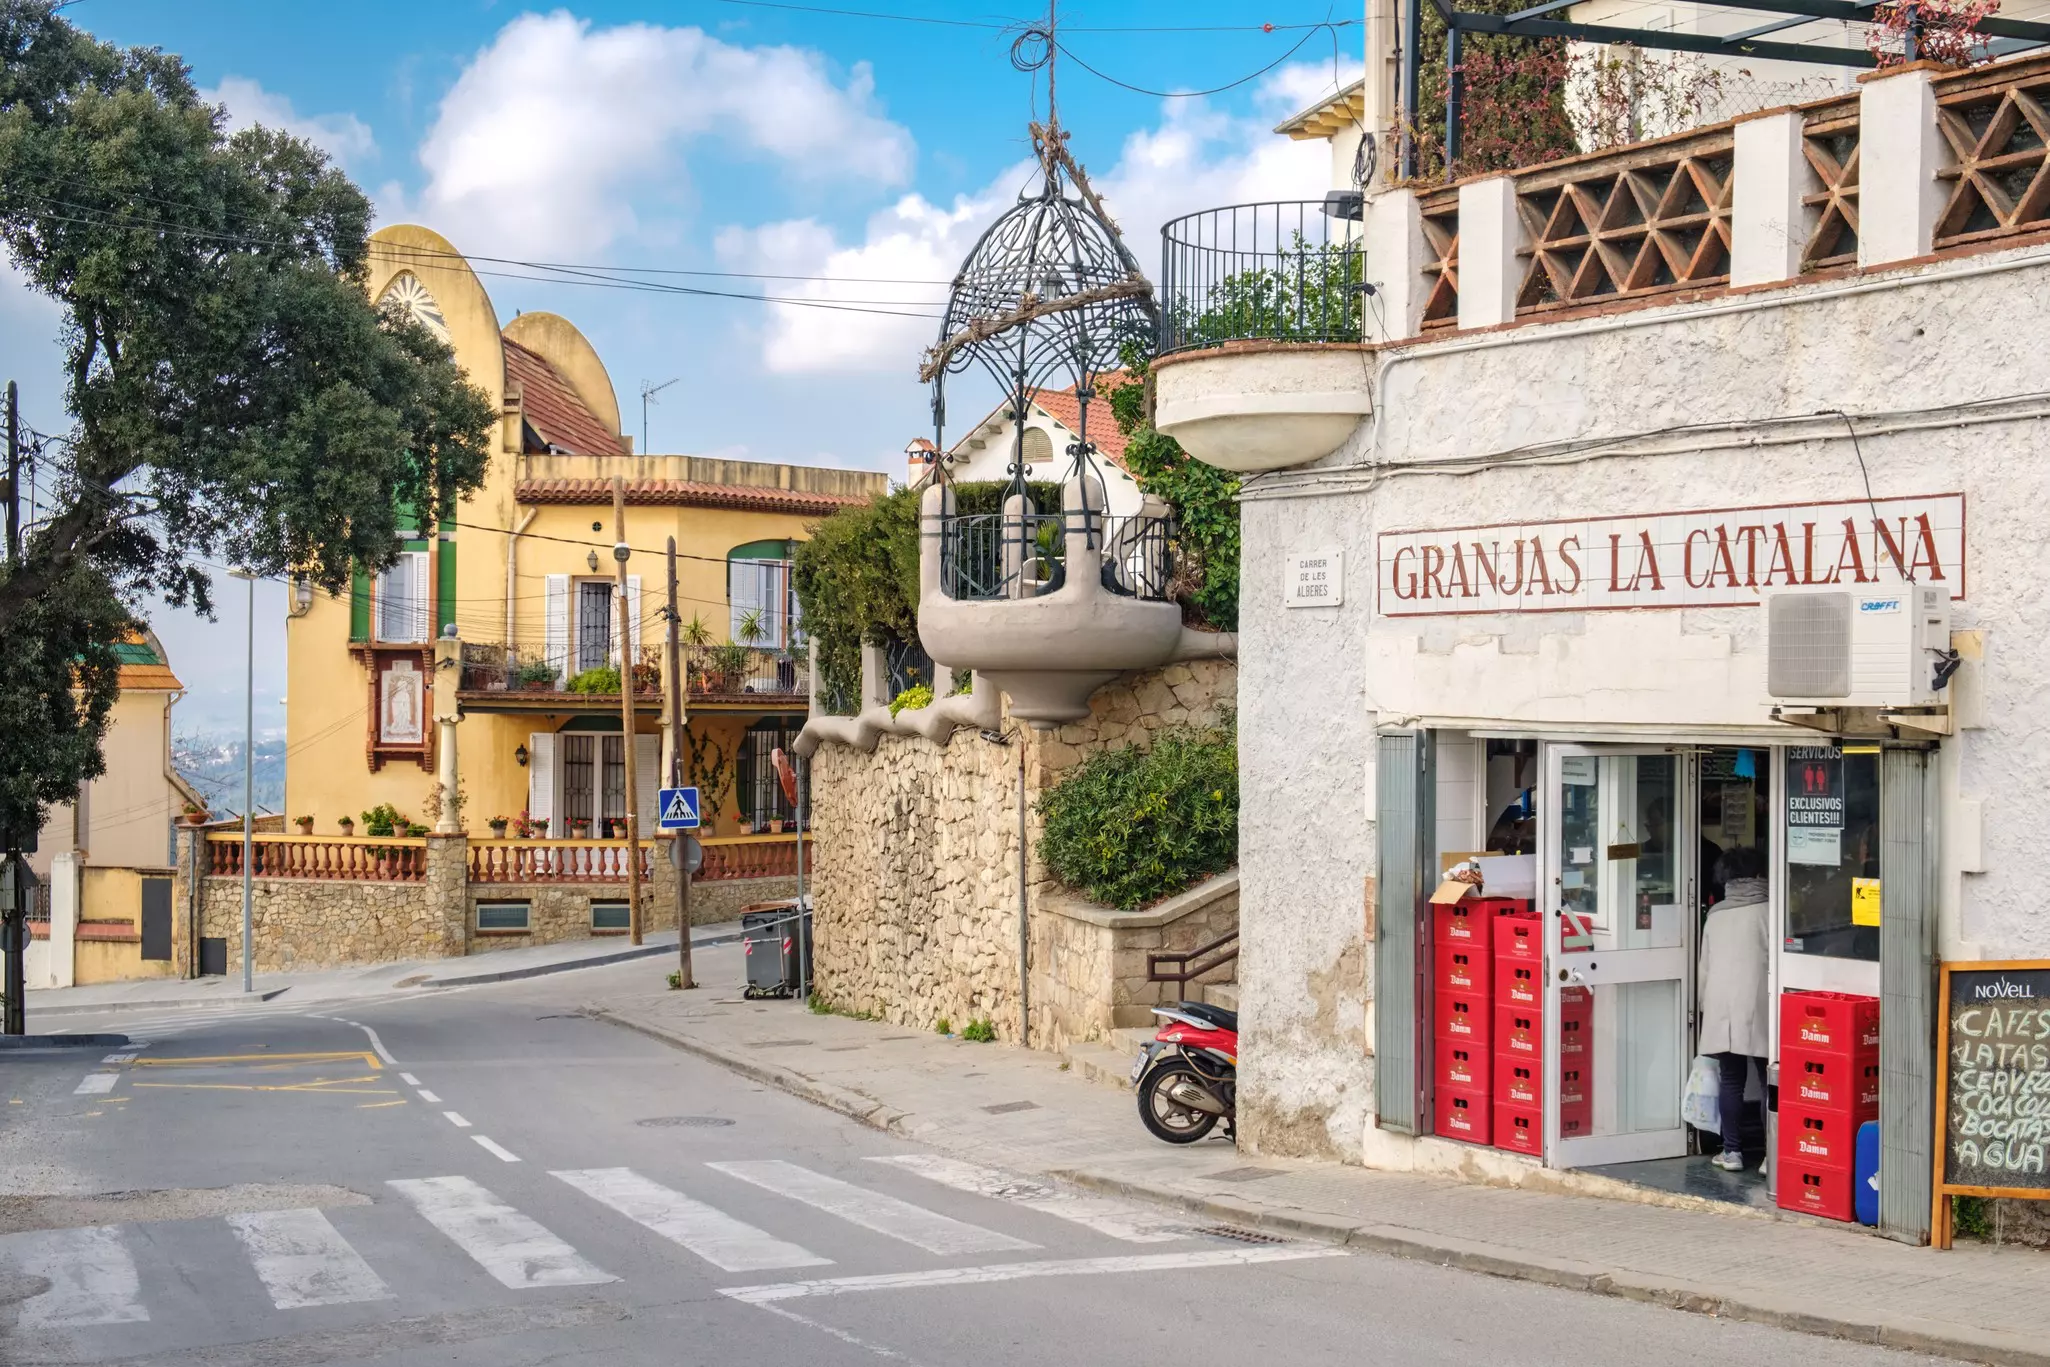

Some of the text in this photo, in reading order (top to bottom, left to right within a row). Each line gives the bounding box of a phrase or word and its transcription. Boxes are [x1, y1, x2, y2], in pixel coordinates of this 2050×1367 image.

[1392, 511, 1947, 600] GRANJAS LA CATALANA
[1299, 559, 1327, 569] CARRER
[1300, 571, 1327, 581] DE LES
[1296, 584, 1329, 598] ALBERES
[1790, 745, 1842, 760] SERVICIOS
[1789, 797, 1842, 810] EXCLUSIVOS
[1789, 811, 1840, 825] CLIENTES!!!
[1958, 1007, 2050, 1040] CAFES
[1801, 1028, 1830, 1043] Damm
[1862, 1034, 1879, 1046] Dam
[1959, 1040, 2048, 1071] LATAS
[1800, 1085, 1829, 1101] Damm
[1861, 1092, 1879, 1103] Dam
[1799, 1140, 1828, 1156] Damm
[1958, 1138, 2045, 1174] AGUA
